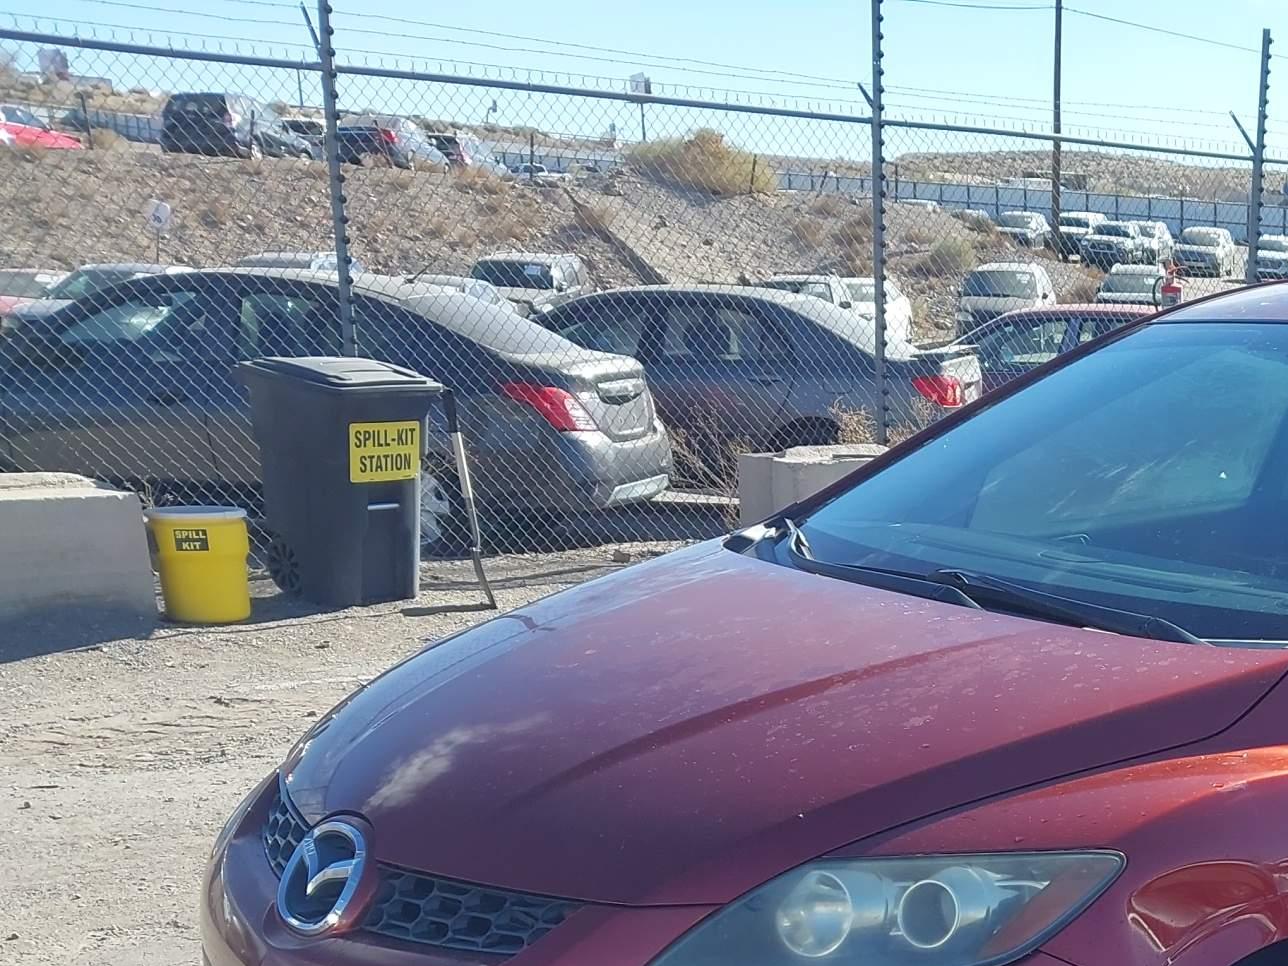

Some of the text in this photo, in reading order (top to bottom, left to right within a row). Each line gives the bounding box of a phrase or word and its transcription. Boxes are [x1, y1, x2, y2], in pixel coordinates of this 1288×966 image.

[353, 427, 416, 449] SPILL-KIT
[358, 452, 412, 474] STATION
[174, 529, 207, 540] SPILL
[181, 540, 202, 551] KIT
